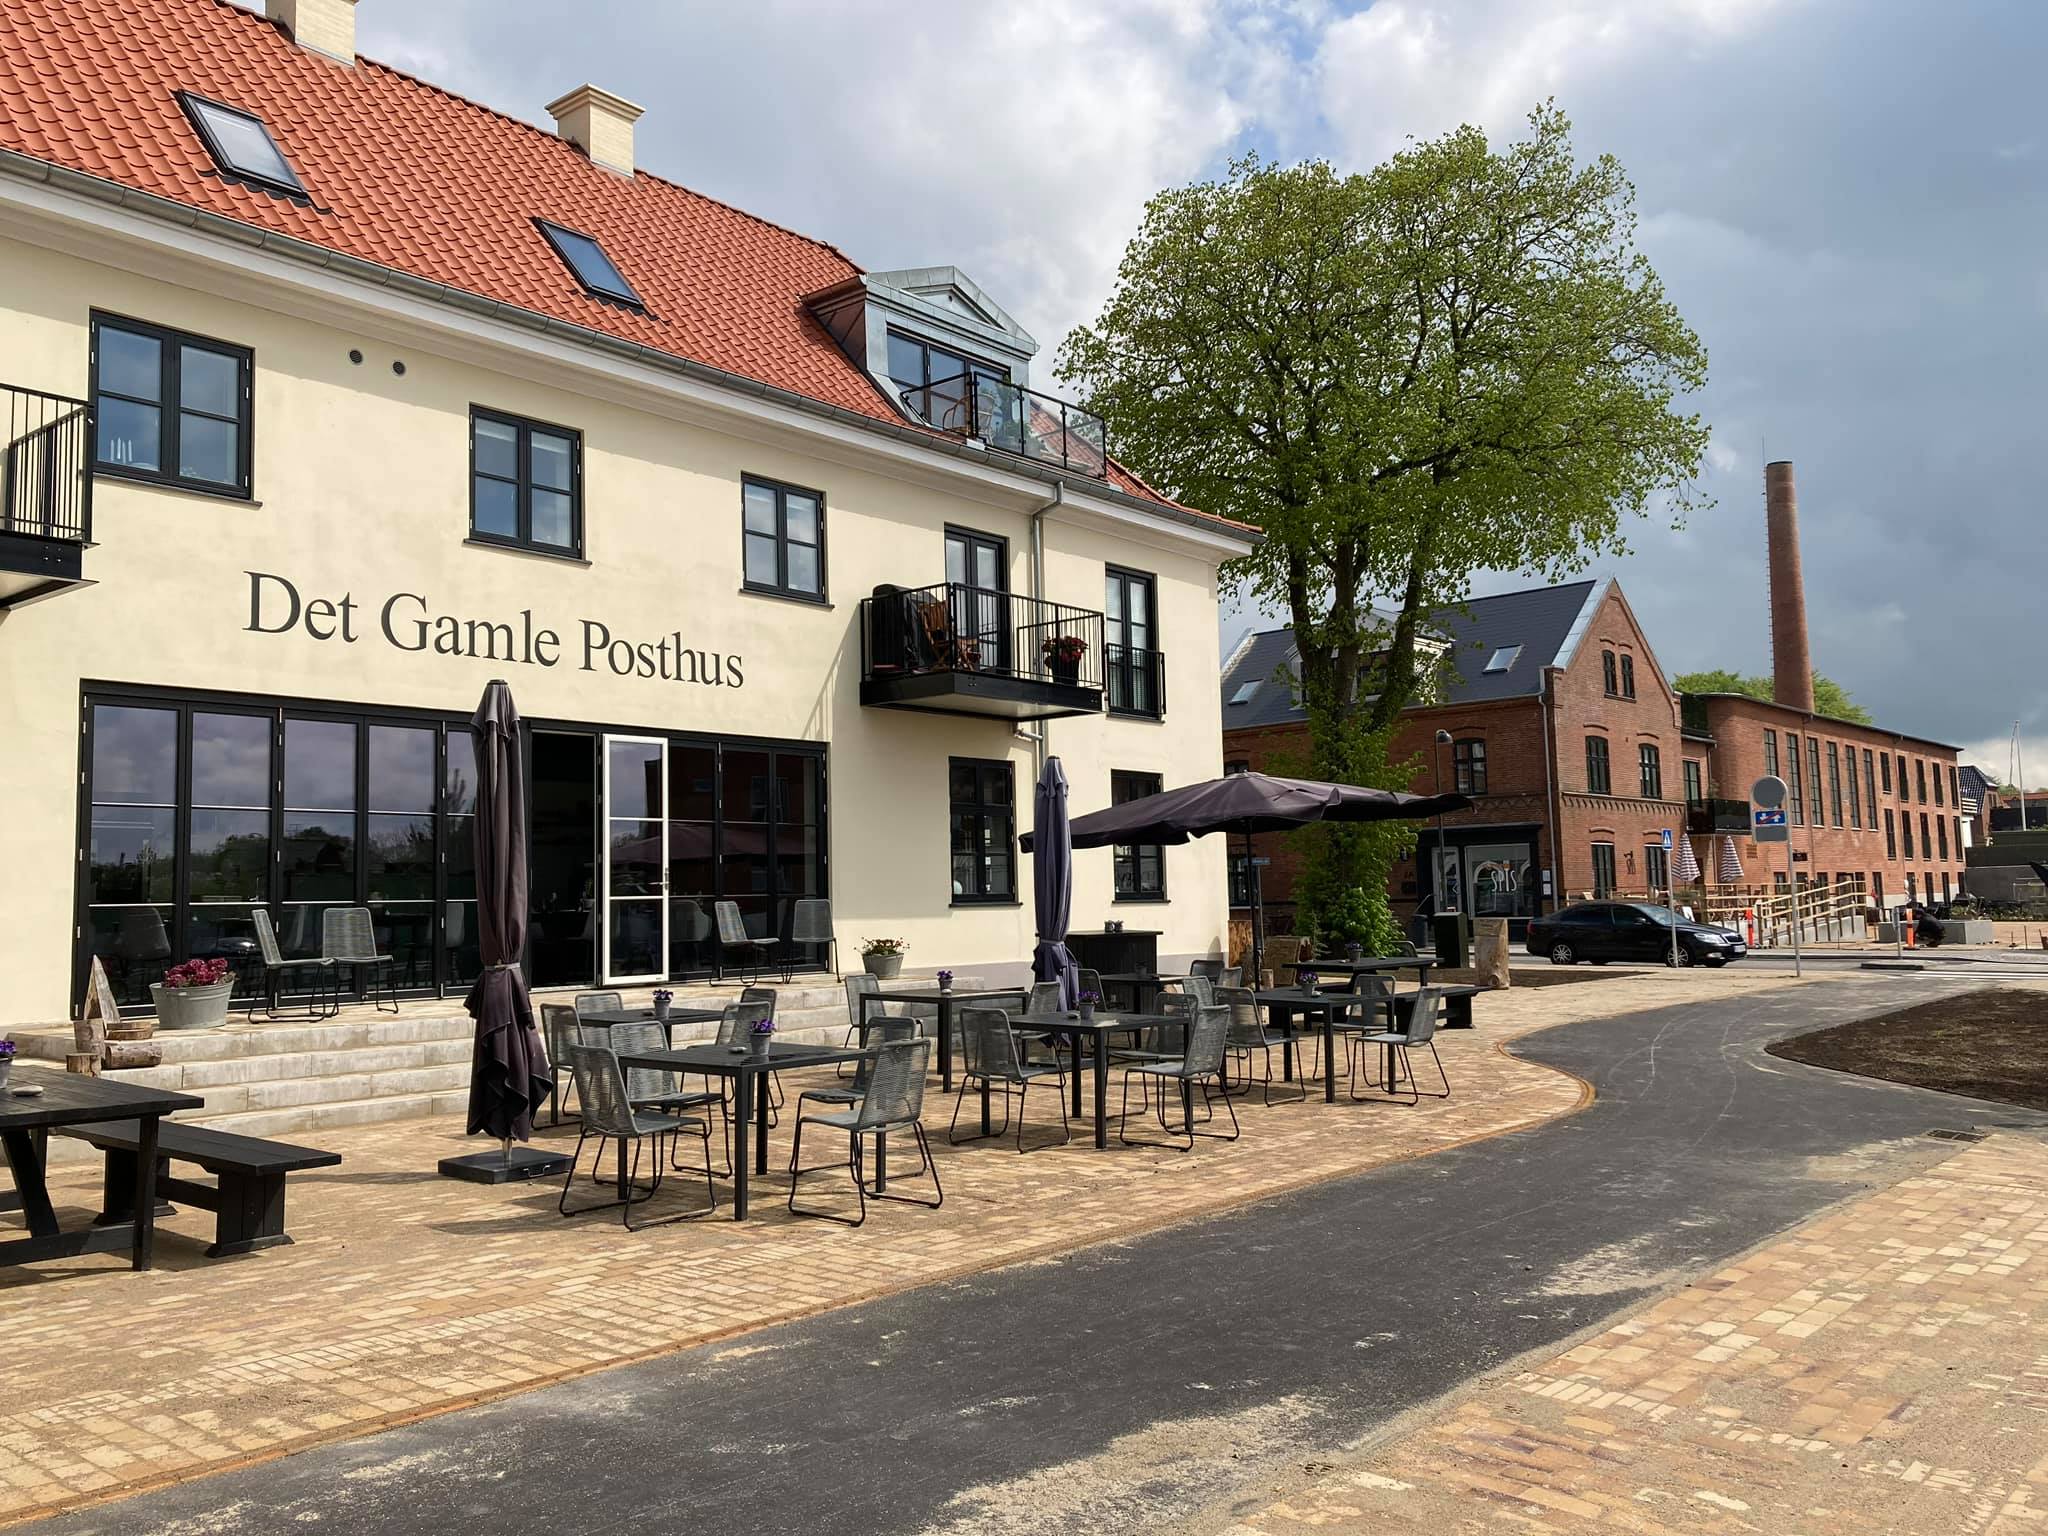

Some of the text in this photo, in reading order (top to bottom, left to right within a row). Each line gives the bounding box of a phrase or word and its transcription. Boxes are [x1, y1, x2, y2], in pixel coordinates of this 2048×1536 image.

[243, 571, 744, 689] Det Gamle Posthus
[1491, 865, 1517, 892] SPIS
